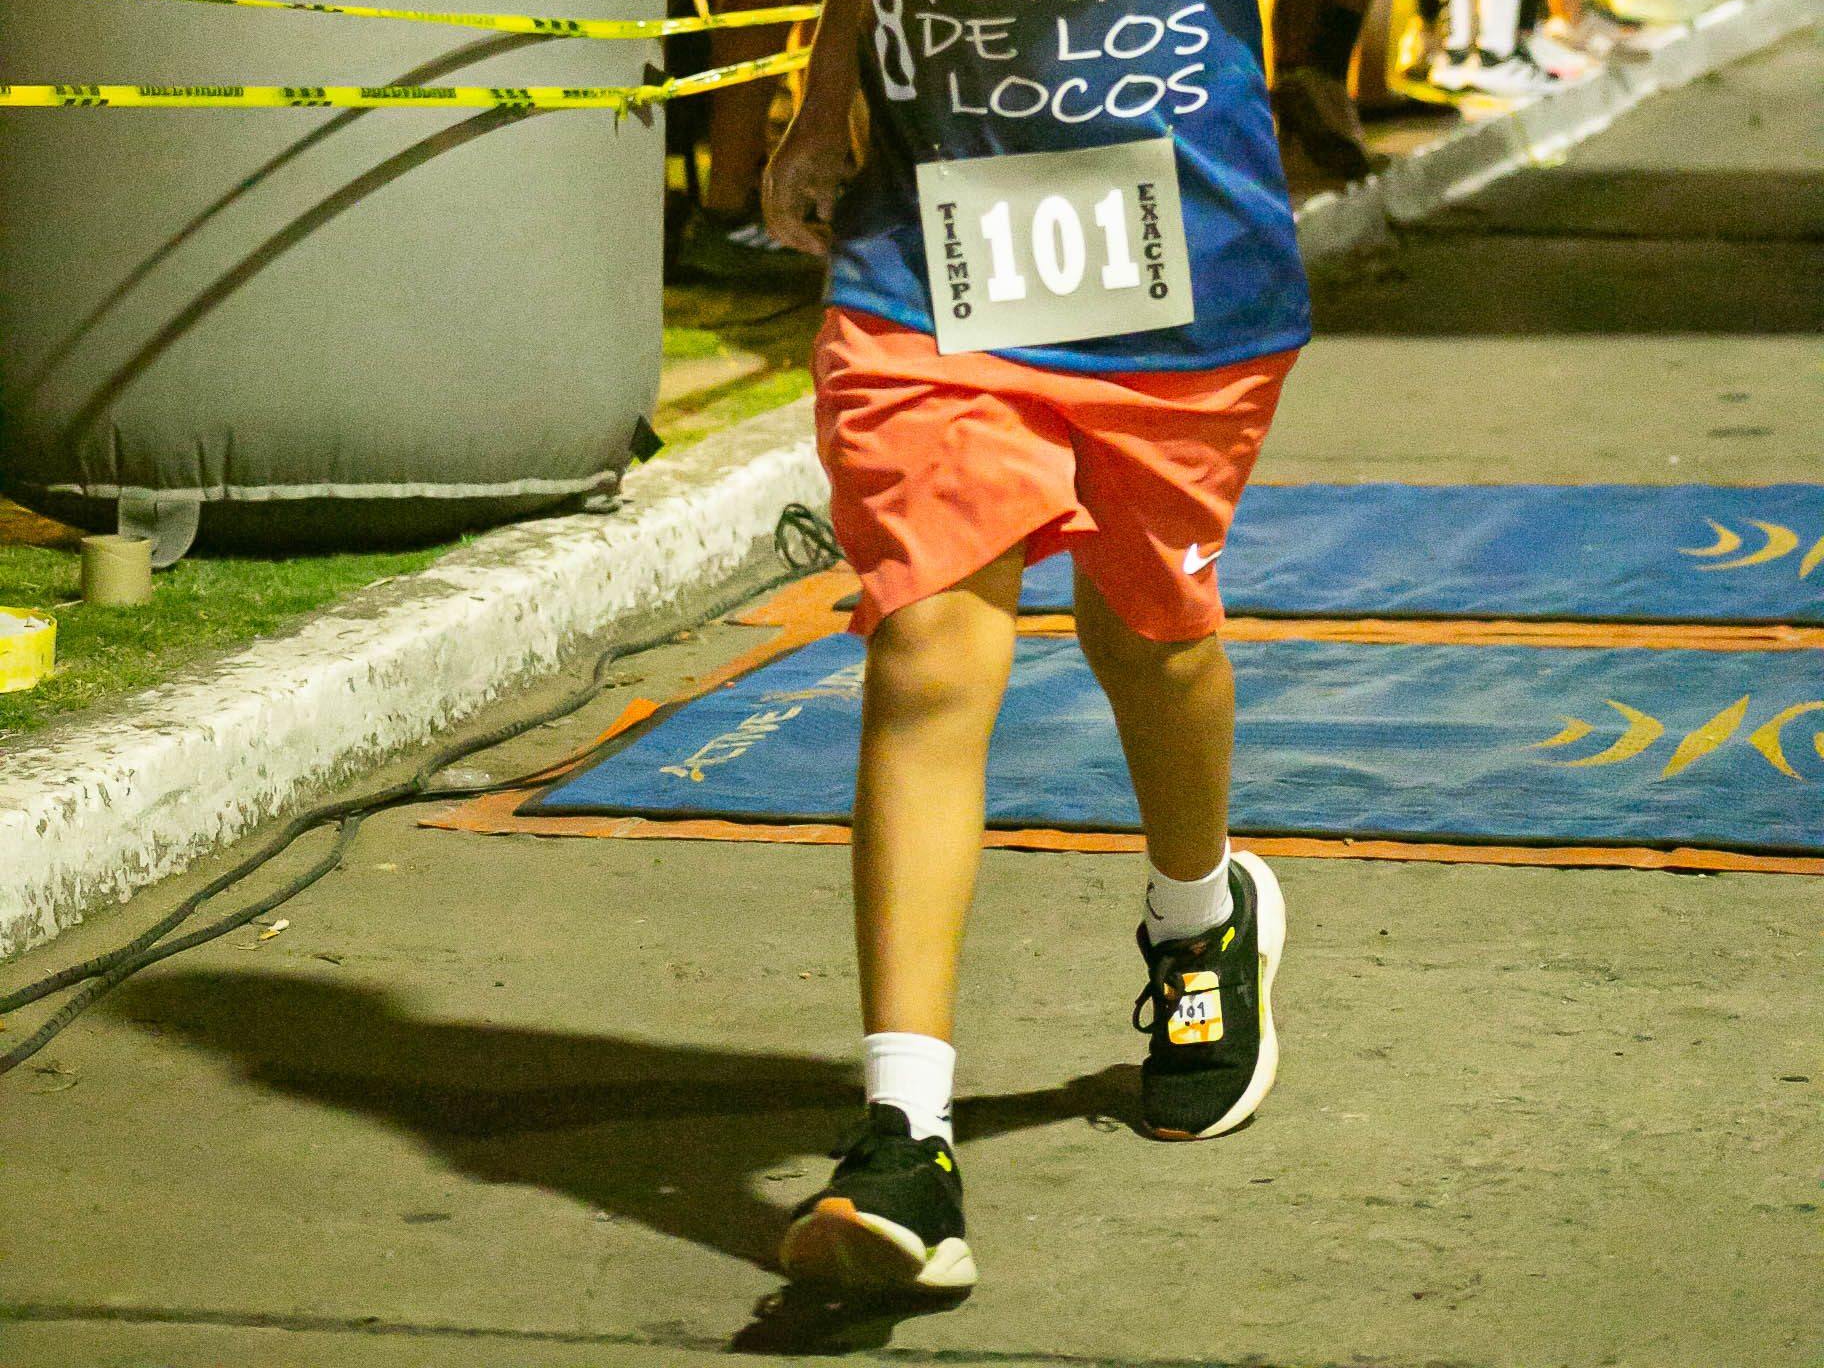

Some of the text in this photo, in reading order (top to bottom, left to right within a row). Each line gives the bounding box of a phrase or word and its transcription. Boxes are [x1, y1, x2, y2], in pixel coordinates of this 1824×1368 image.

[914, 3, 1210, 61] DE LOS
[949, 62, 1209, 124] LOCOS
[937, 202, 973, 320] TIEMPO
[980, 188, 1141, 303] 101
[1137, 183, 1169, 300] EXACTO
[1177, 1001, 1206, 1019] 101
